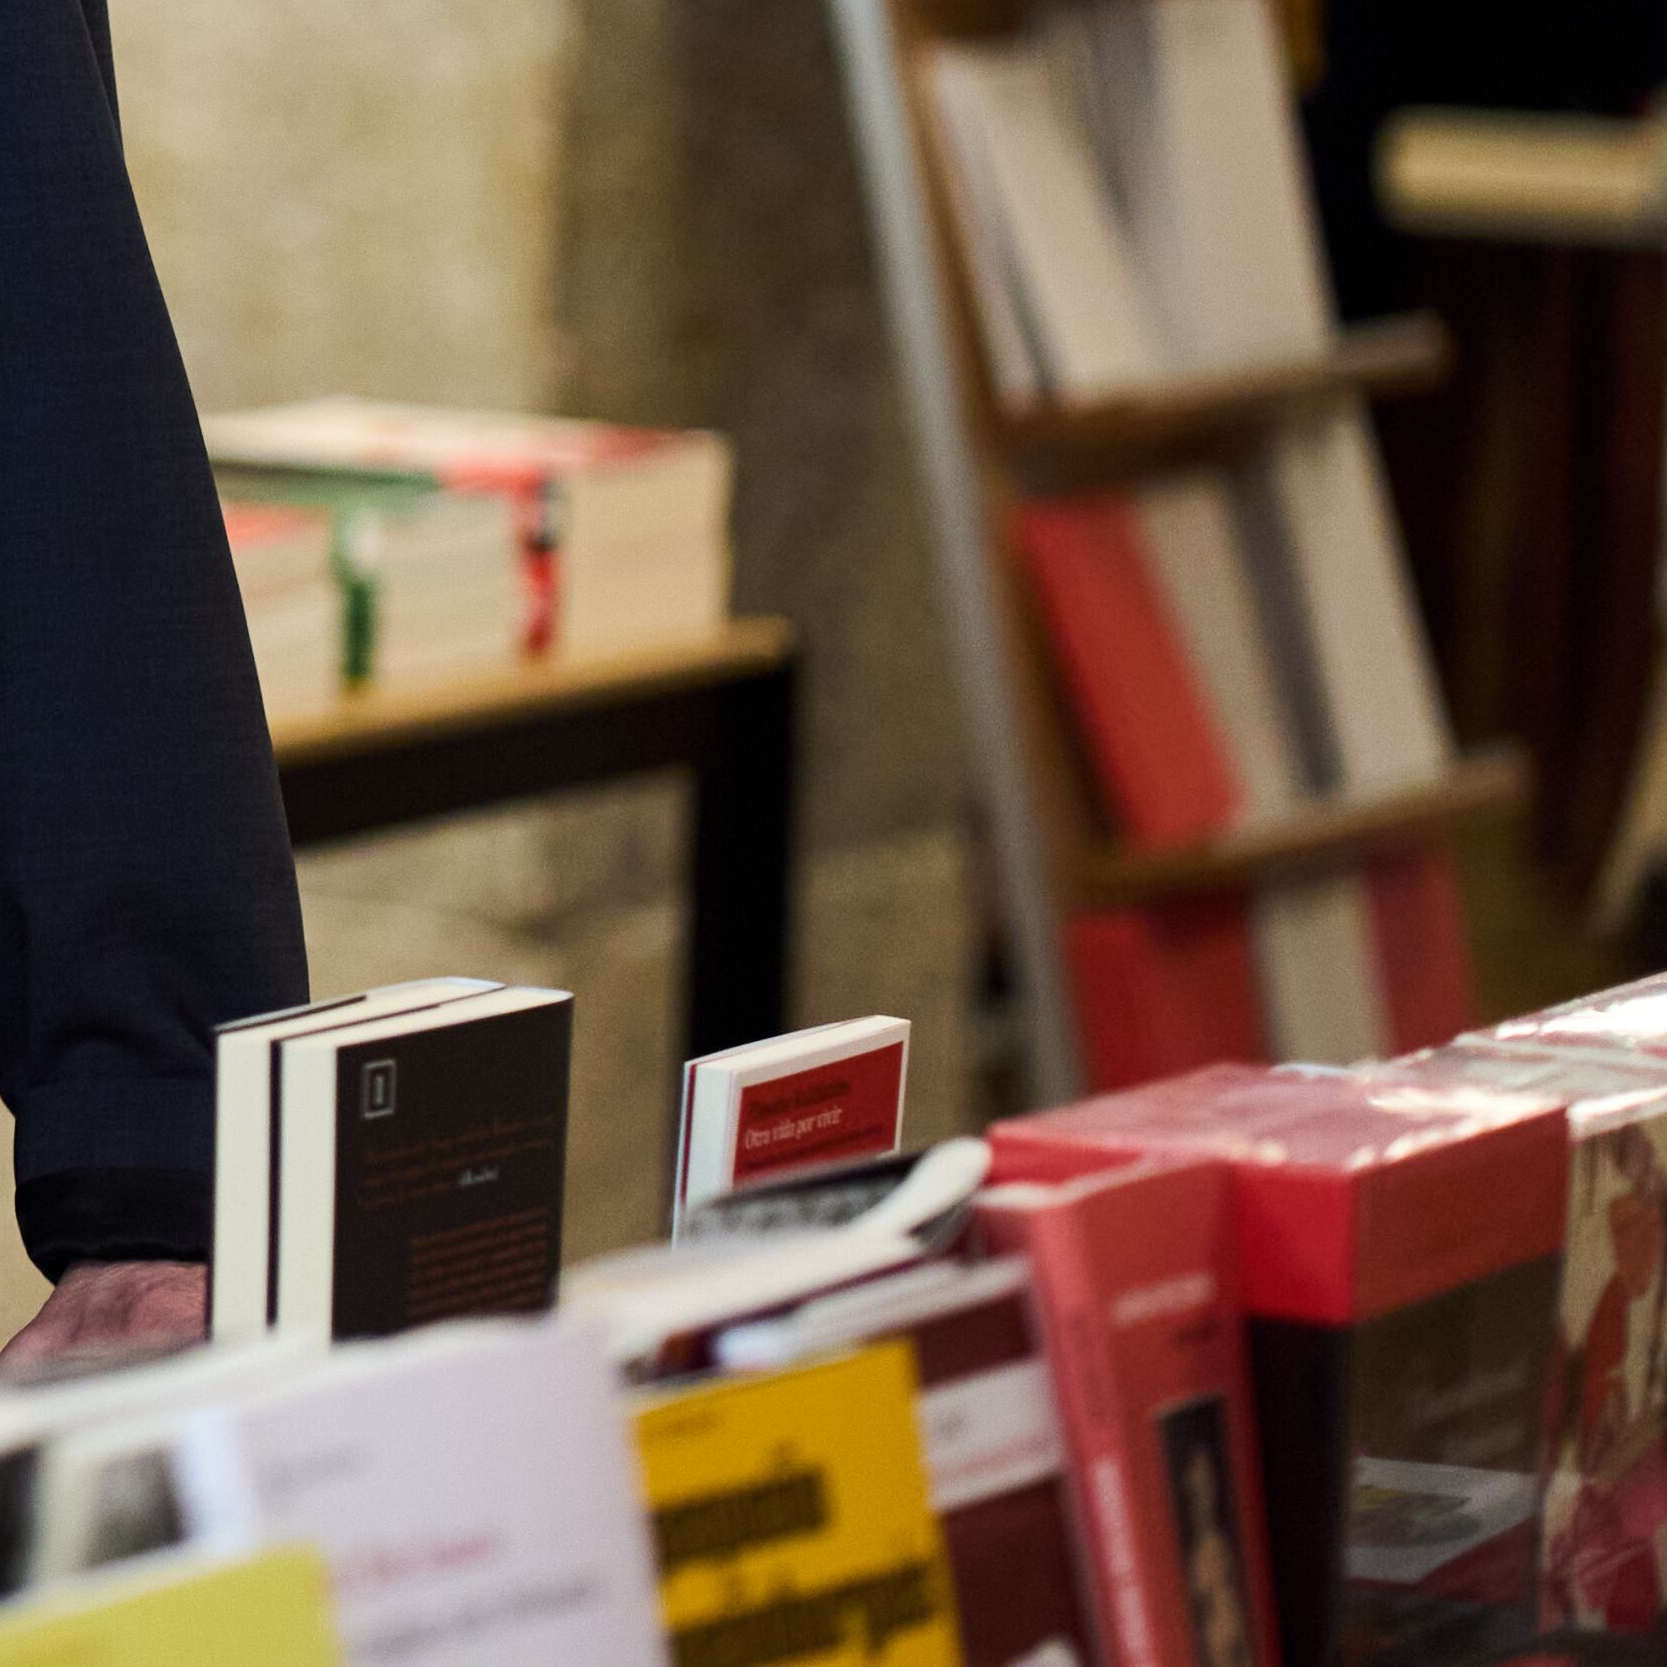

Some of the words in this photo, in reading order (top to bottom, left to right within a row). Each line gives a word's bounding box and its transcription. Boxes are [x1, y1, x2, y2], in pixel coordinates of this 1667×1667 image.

[745, 1126, 771, 1150] Otra
[772, 1118, 796, 1141] vida
[795, 1115, 814, 1140] por
[816, 1105, 843, 1129] vivir
